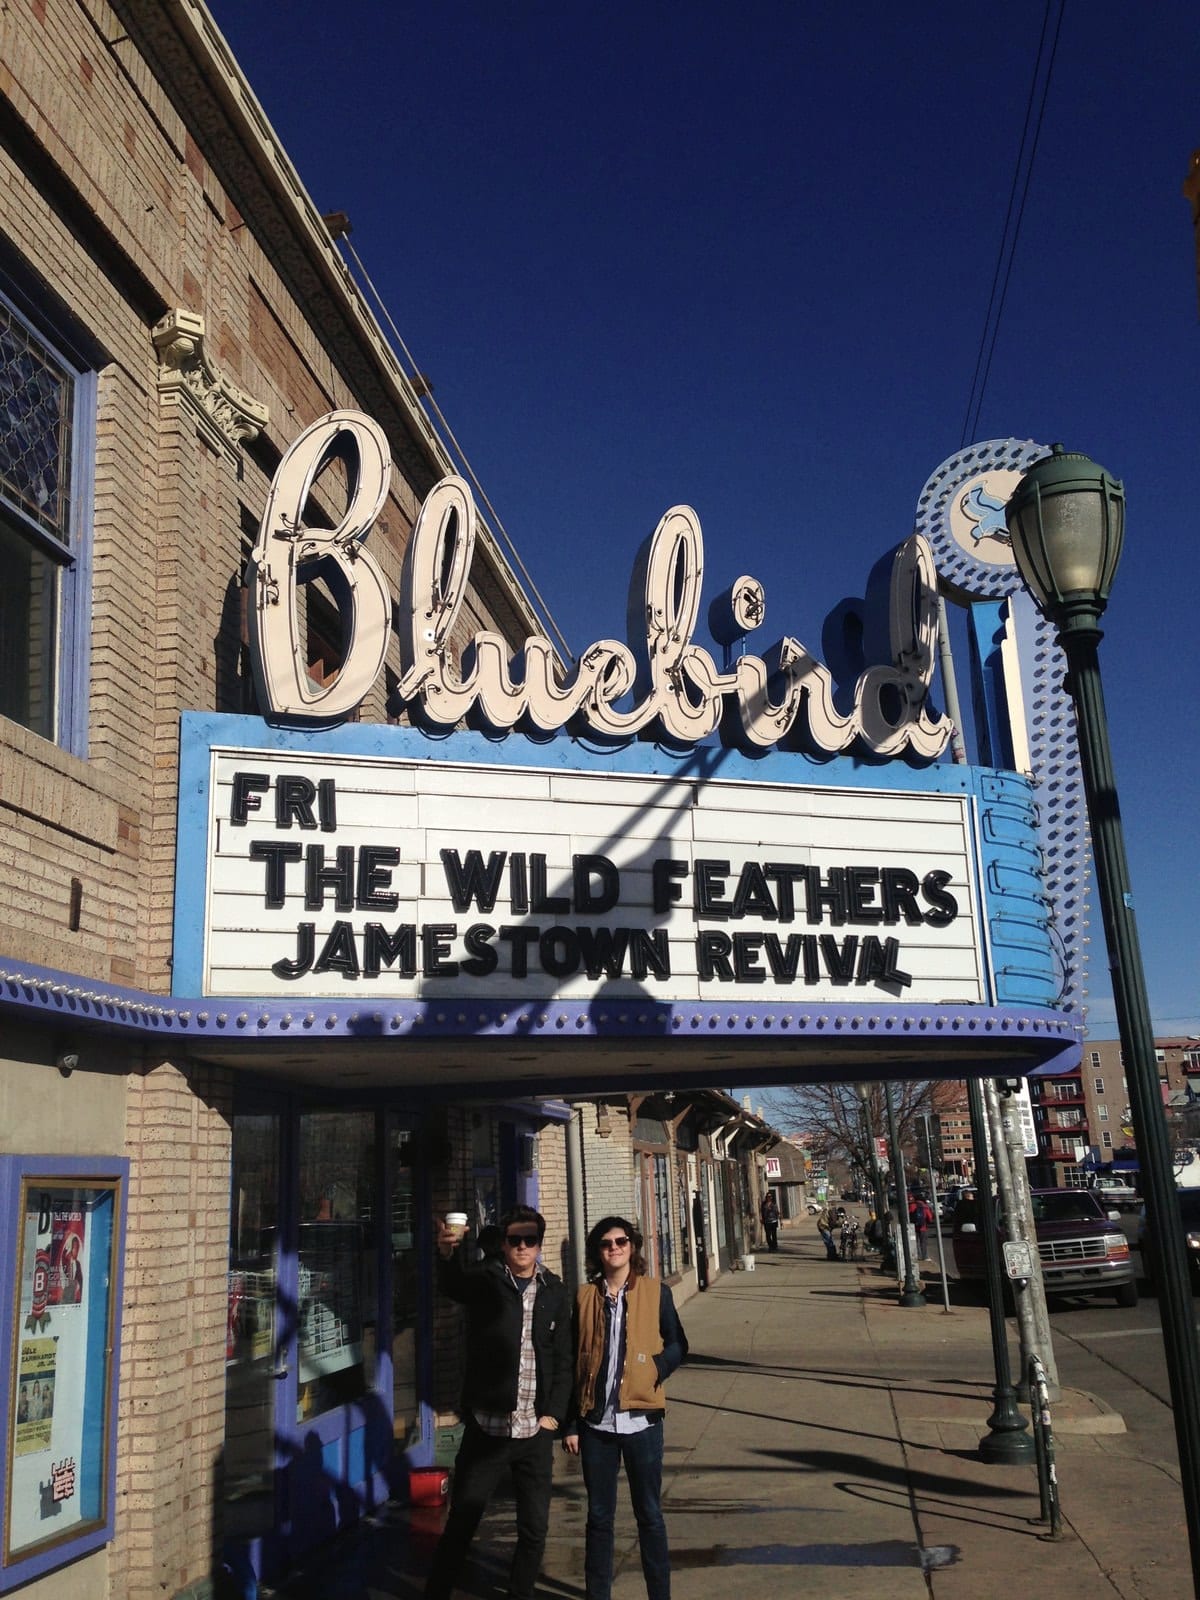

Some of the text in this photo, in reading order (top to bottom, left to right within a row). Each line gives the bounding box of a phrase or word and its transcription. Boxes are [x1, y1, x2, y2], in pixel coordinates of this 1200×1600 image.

[251, 409, 953, 760] Bluebird
[230, 772, 336, 832] FRI
[250, 841, 958, 927] THE WILD FEATHERS
[271, 920, 671, 981] JAMESTOWN
